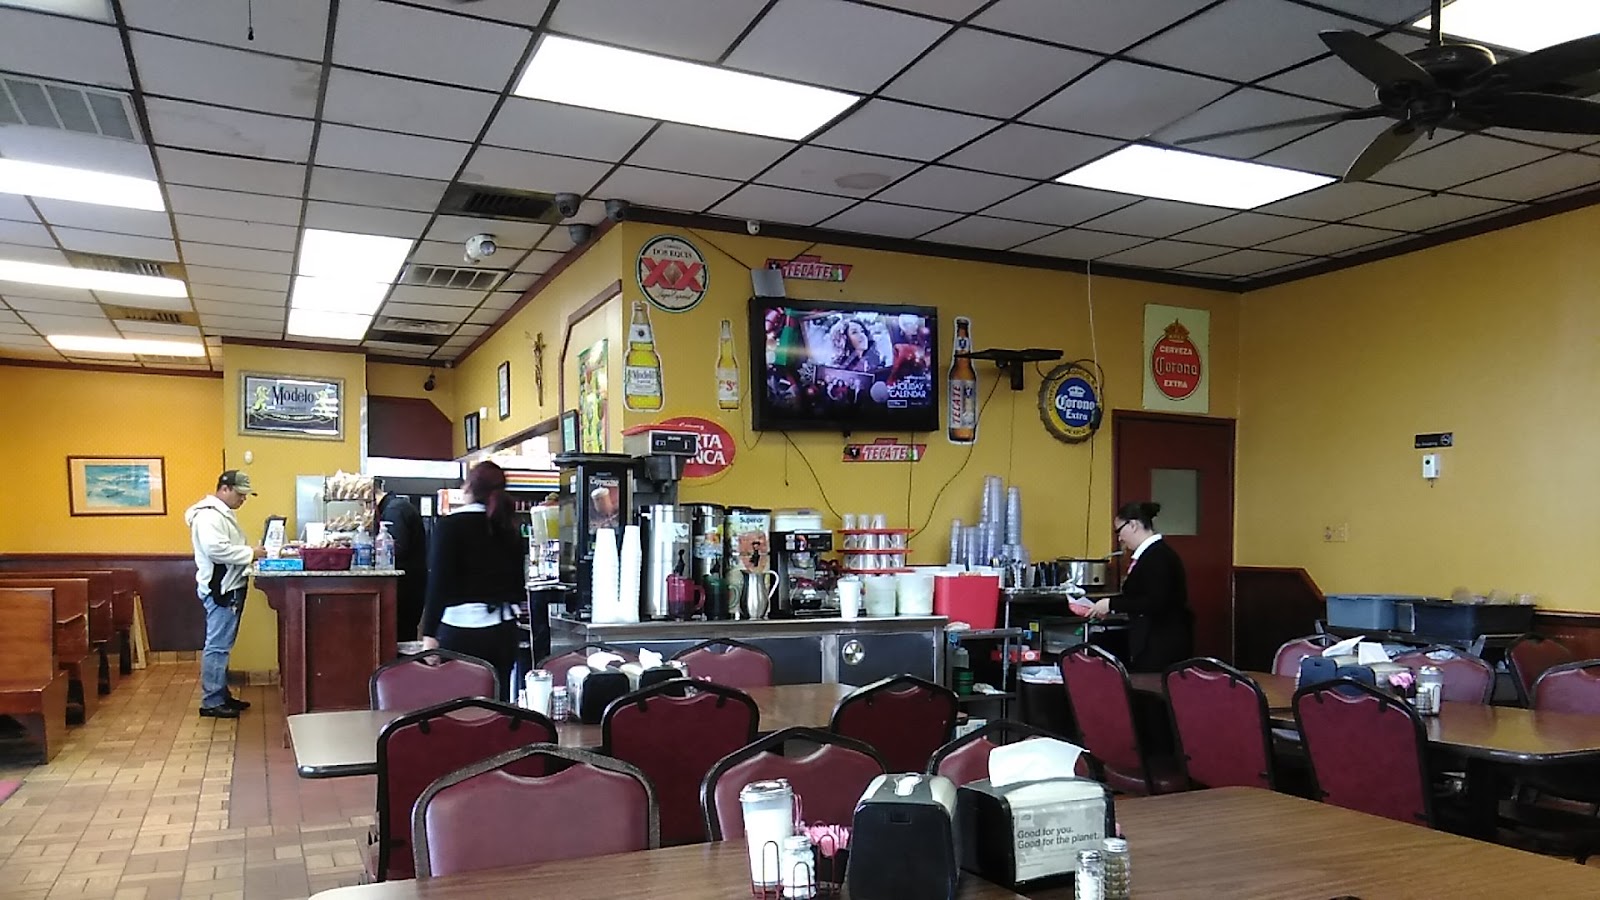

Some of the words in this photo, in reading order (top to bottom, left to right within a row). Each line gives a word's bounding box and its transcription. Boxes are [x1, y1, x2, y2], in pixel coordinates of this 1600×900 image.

[669, 249, 693, 259] EQUIS
[783, 262, 831, 279] TECATE
[1160, 346, 1192, 355] CERVEZA
[1155, 356, 1198, 376] Corona
[1164, 380, 1188, 388] EXTRA
[271, 385, 315, 406] Modelo
[1055, 394, 1096, 411] Corona
[952, 384, 961, 425] TECATE
[1066, 409, 1088, 420] Extra
[863, 445, 908, 460] TECATE
[739, 516, 764, 525] Superior
[1017, 829, 1041, 839] Good
[1042, 827, 1055, 836] for
[1057, 827, 1074, 836] you.
[1017, 840, 1041, 850] Good
[1042, 838, 1054, 847] for
[1056, 836, 1070, 845] the
[1071, 832, 1100, 845] planet.
